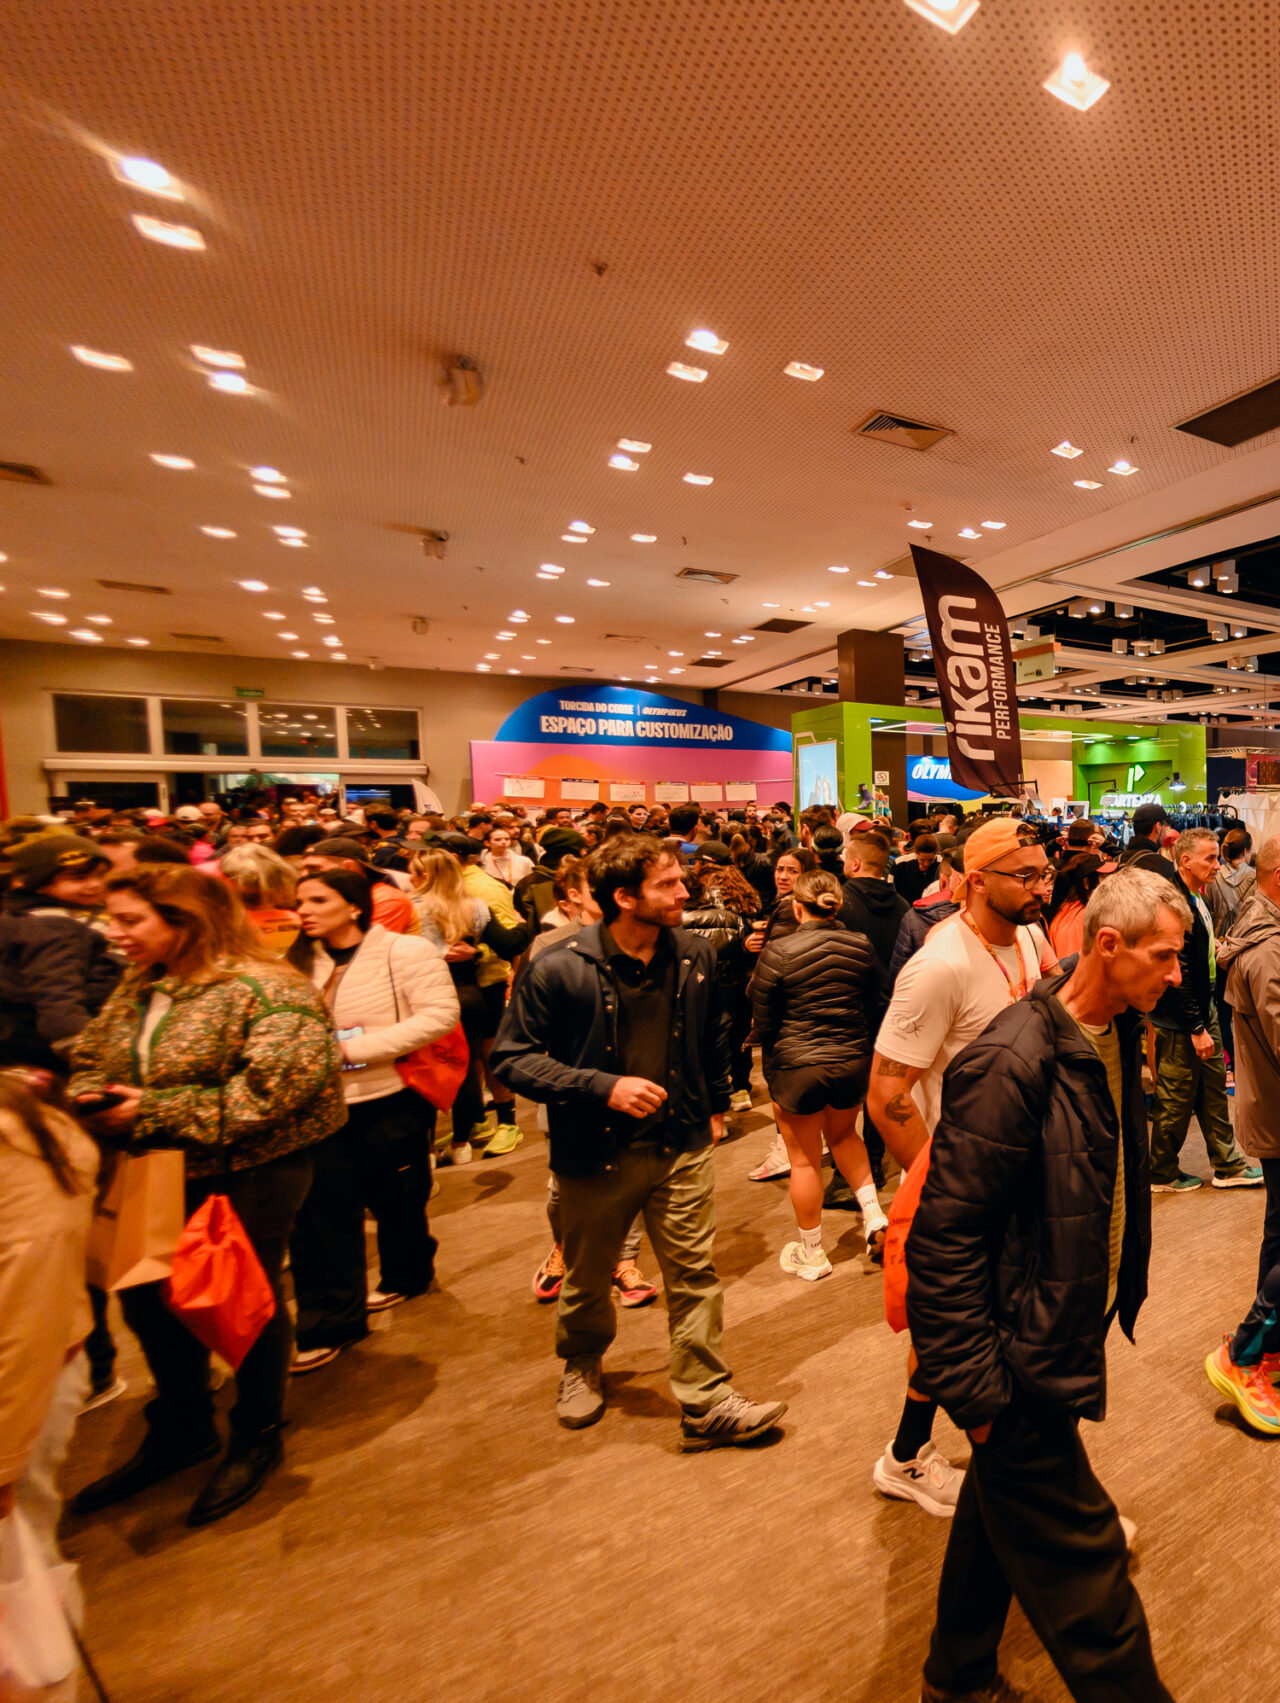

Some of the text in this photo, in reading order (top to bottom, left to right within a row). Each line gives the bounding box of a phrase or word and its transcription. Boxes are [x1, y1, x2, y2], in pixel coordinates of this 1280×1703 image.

[938, 594, 996, 761] rikam
[984, 623, 1012, 740] PERFORMANCE
[559, 700, 594, 712] TORCIDA
[595, 702, 607, 713] DO
[540, 715, 734, 742] ESPAÇO PARA CUSTOMIZAÇÃO
[912, 764, 952, 780] OLYM
